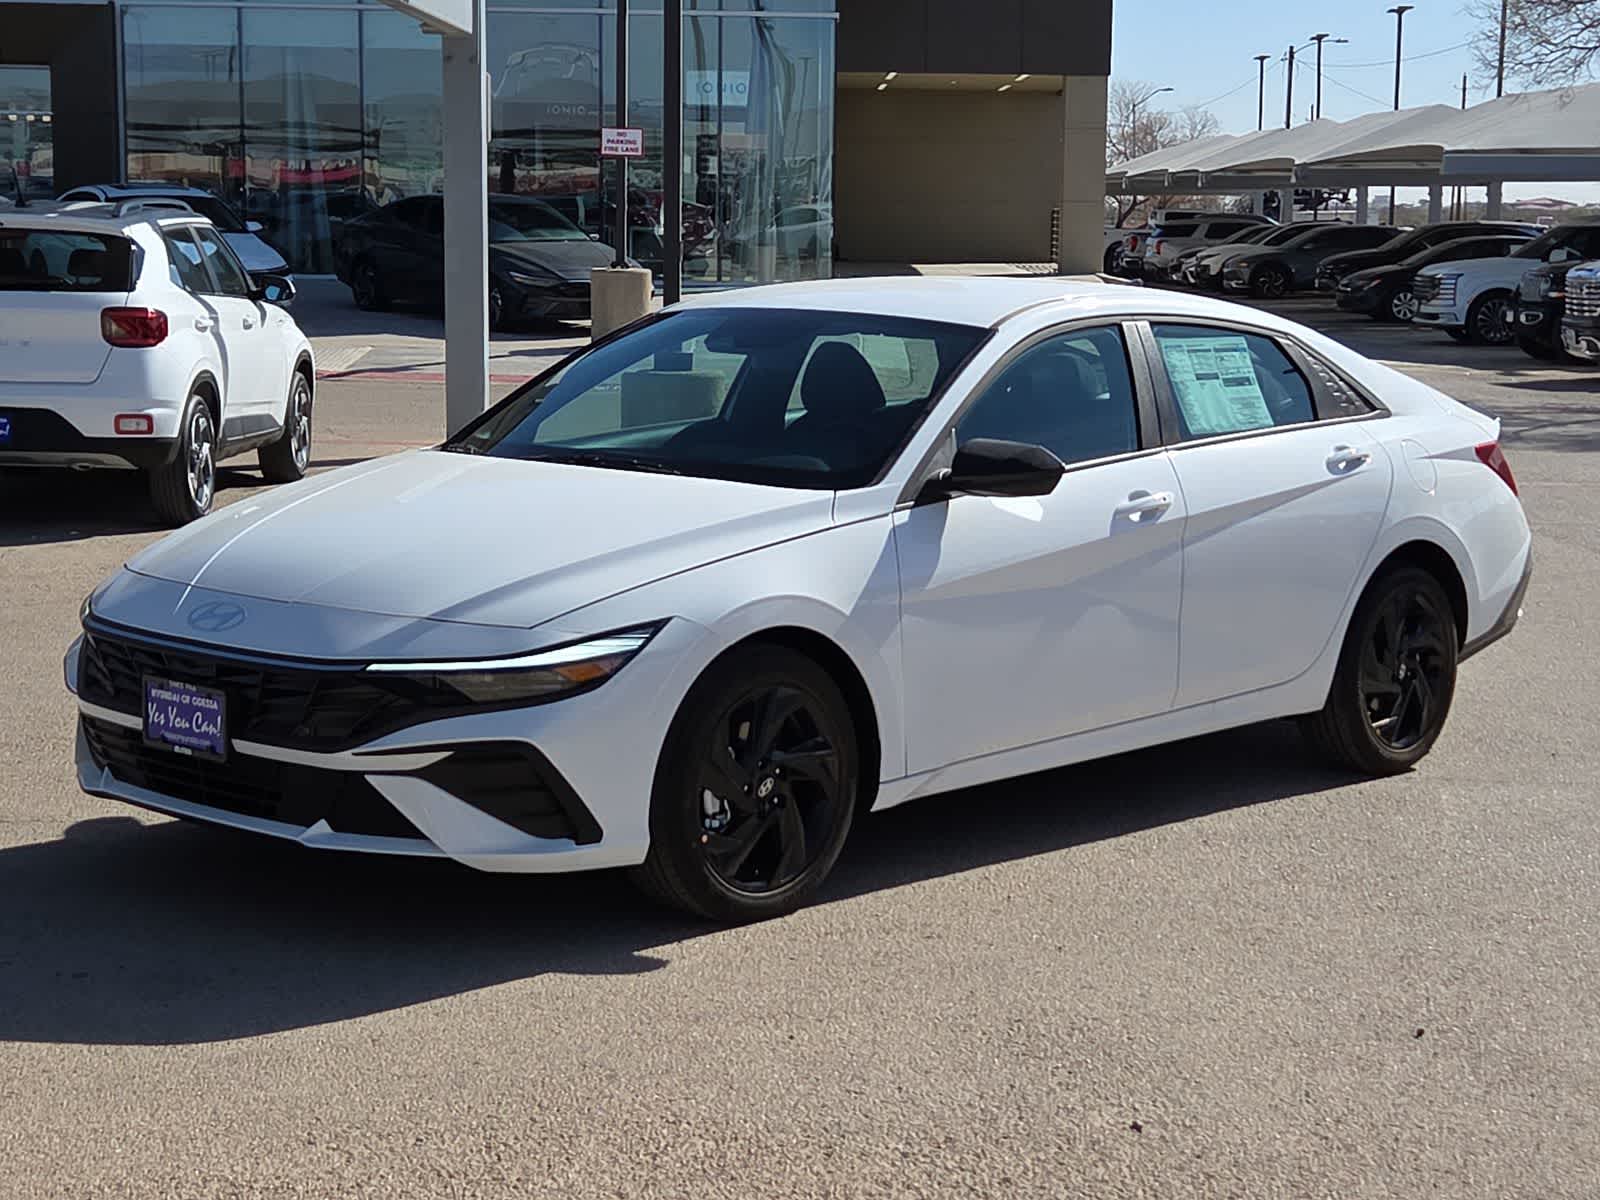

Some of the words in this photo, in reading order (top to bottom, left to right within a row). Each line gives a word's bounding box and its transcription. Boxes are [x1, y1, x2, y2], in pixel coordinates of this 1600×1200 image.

[148, 702, 165, 726] Yes
[168, 705, 190, 728] You
[192, 711, 222, 736] Can!
